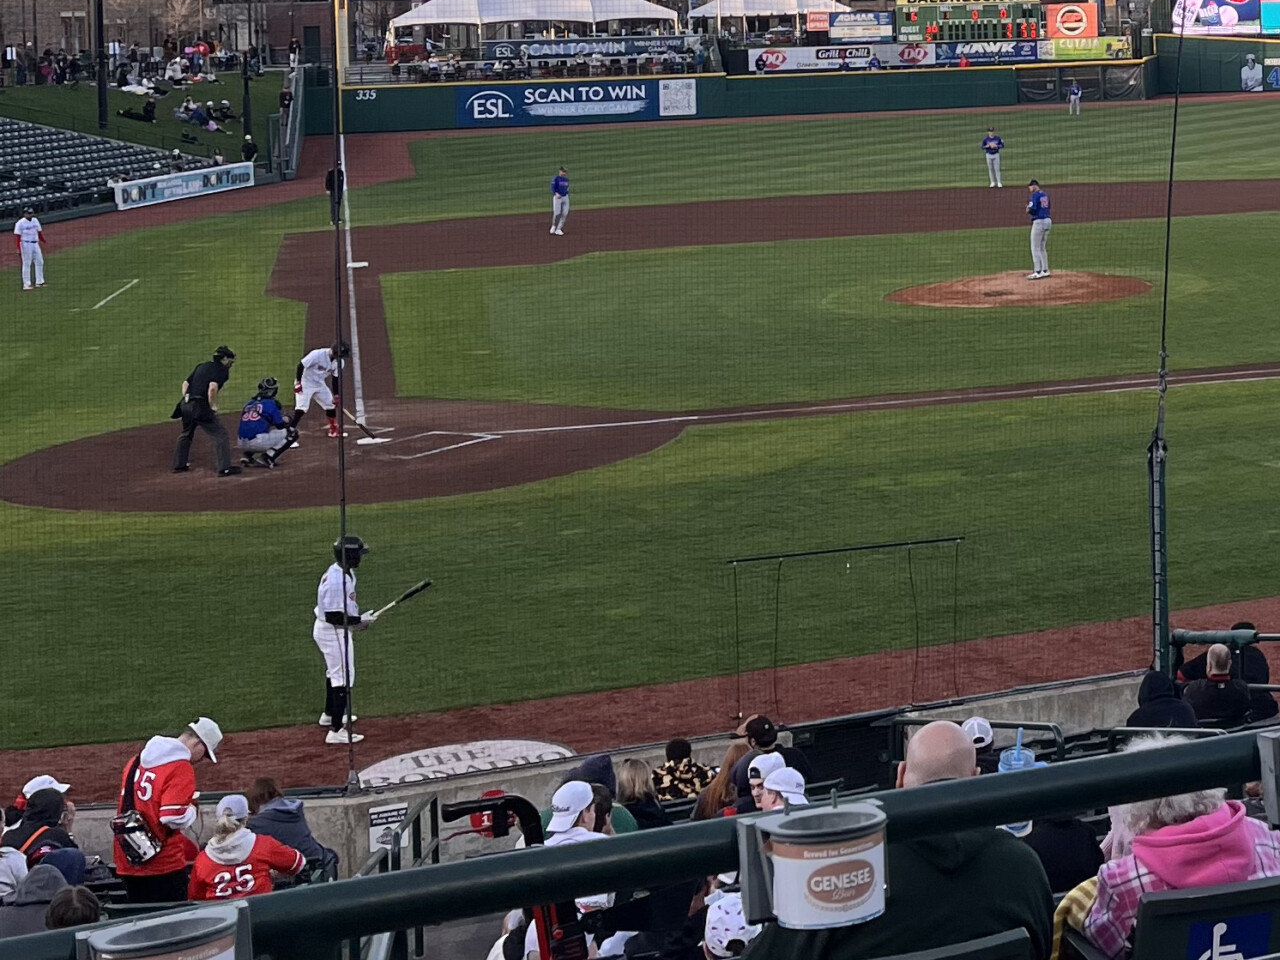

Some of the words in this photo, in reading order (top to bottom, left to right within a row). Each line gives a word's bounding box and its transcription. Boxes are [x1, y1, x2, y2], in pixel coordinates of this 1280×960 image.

[835, 13, 875, 22] ADMAR
[910, 12, 917, 22] 6
[972, 10, 978, 20] 0
[1000, 9, 1007, 19] 0
[495, 46, 514, 57] ESL
[520, 43, 564, 57] SCAN
[568, 42, 589, 55] TO
[592, 41, 625, 54] WIN
[818, 48, 839, 58] Grill
[846, 46, 870, 57] Chill
[903, 47, 925, 60] DQ
[955, 41, 1016, 54] HAWK
[355, 89, 377, 100] 335
[473, 98, 510, 119] ESL
[524, 88, 575, 104] SCAN
[578, 86, 604, 101] TO
[608, 84, 646, 100] WIN
[538, 103, 576, 115] WINNER
[401, 747, 492, 769] THE
[134, 769, 156, 801] 5
[213, 863, 255, 897] 25
[810, 867, 871, 892] GENESEE
